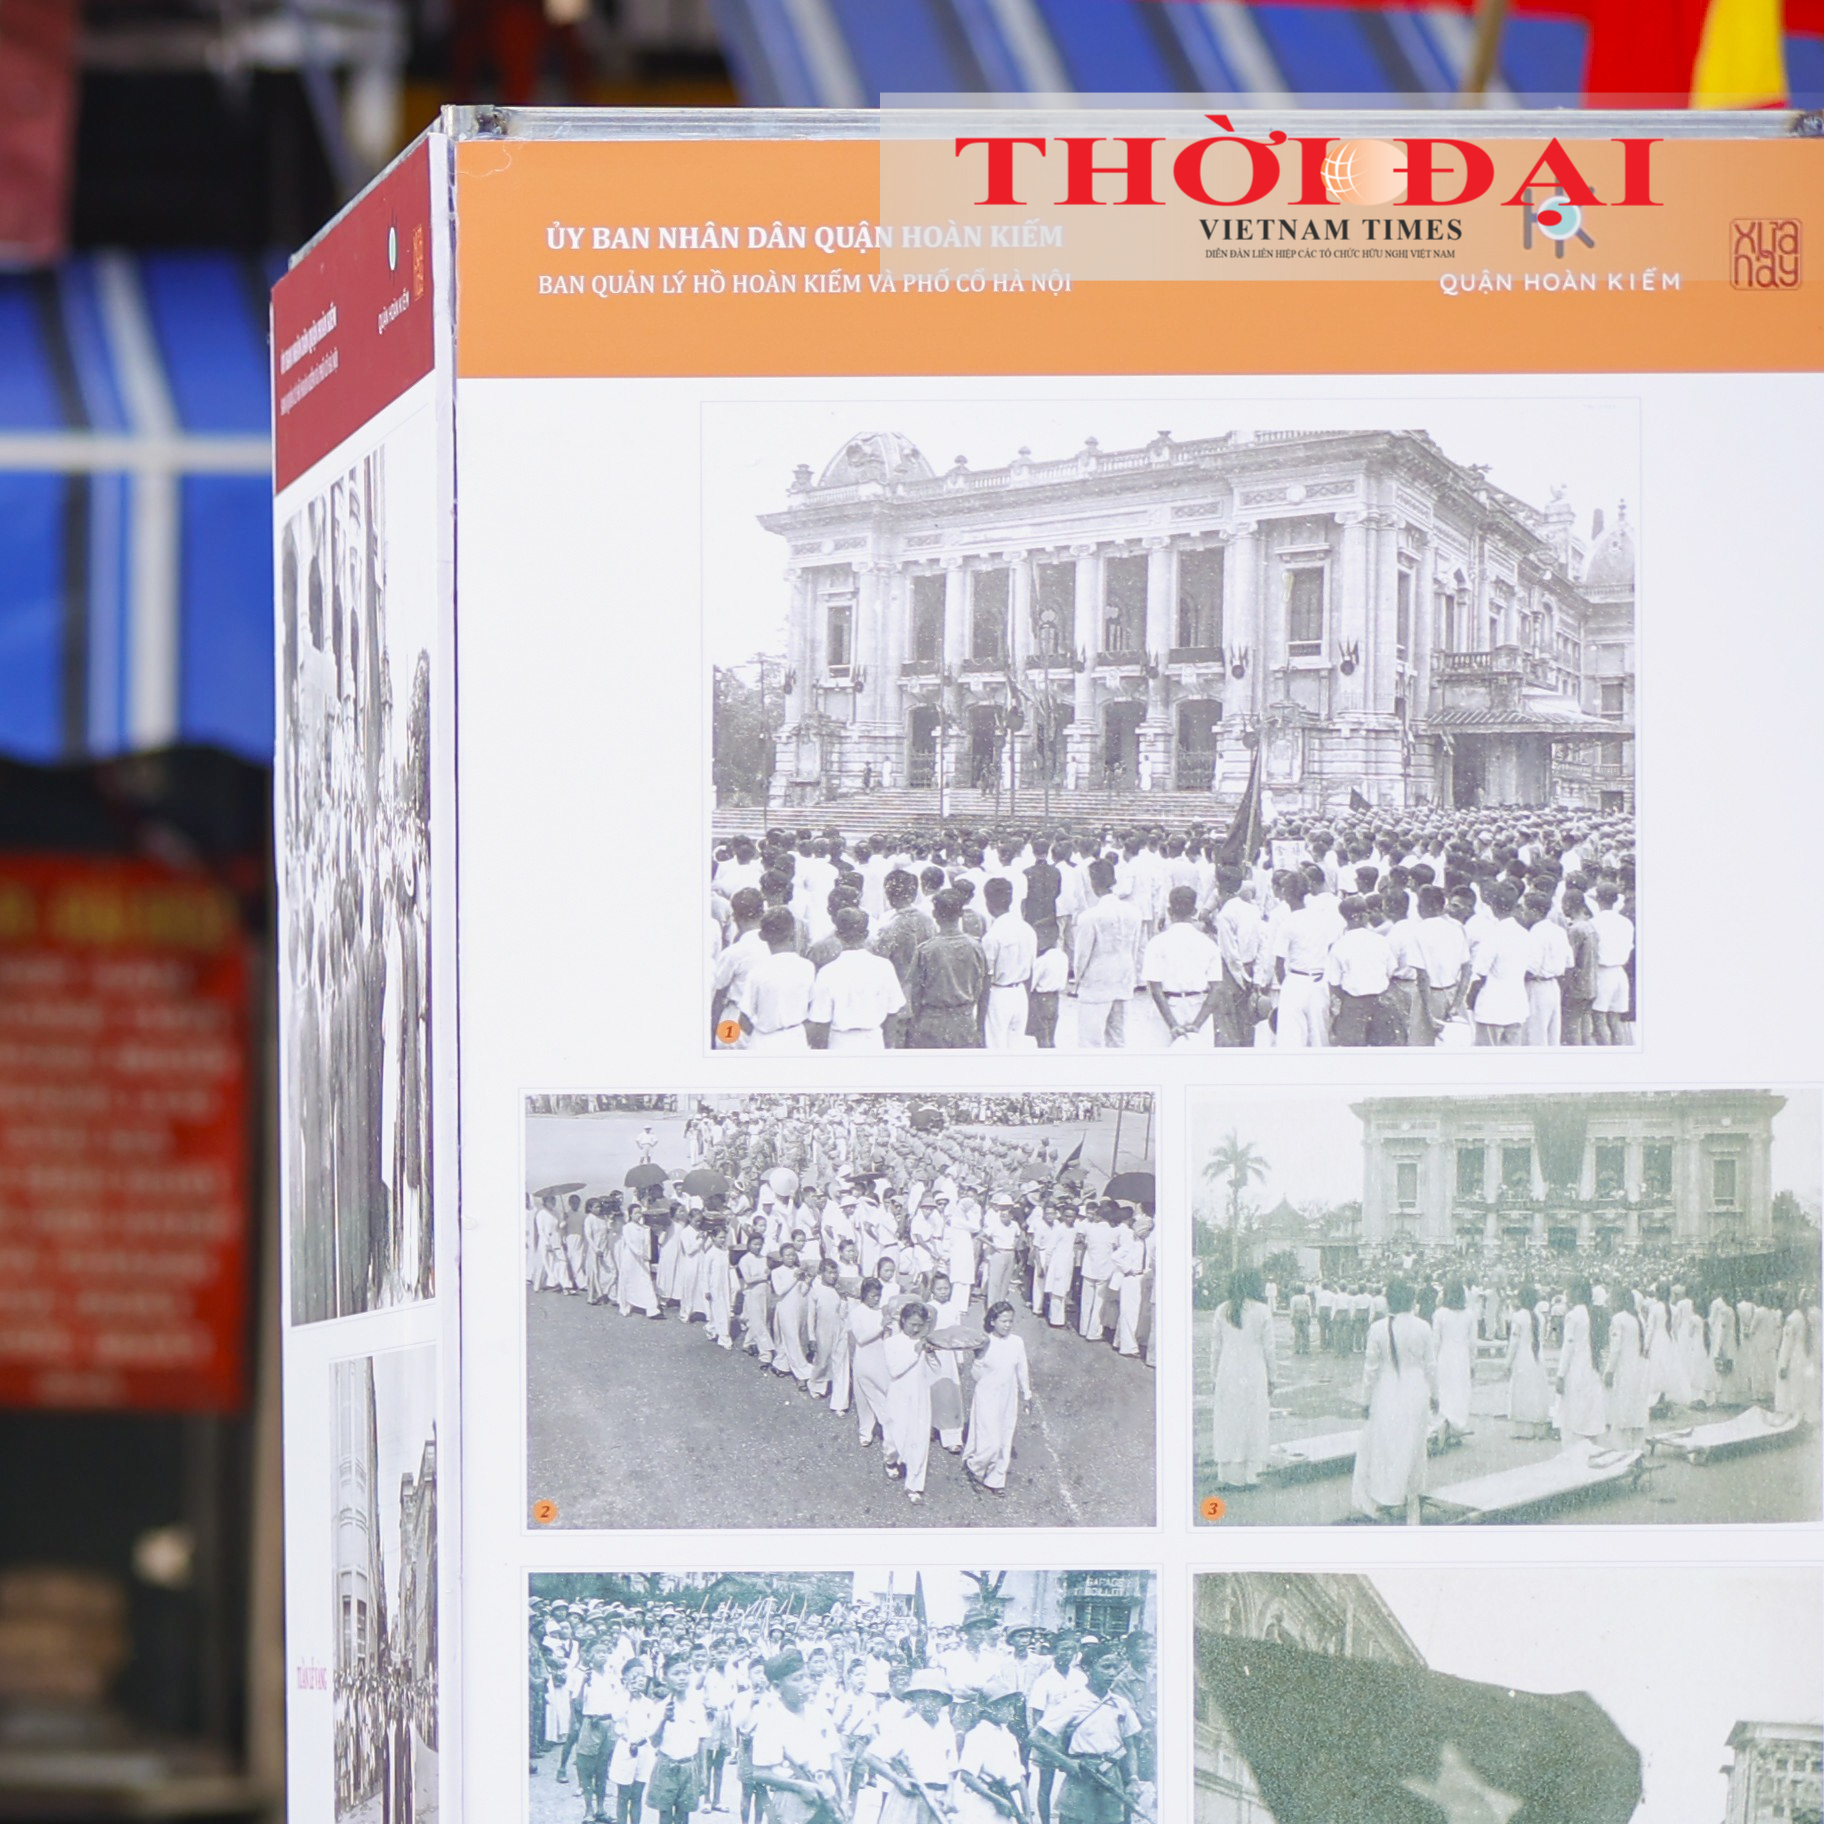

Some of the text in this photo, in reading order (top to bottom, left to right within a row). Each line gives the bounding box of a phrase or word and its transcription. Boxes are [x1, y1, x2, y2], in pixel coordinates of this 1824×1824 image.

[547, 218, 1063, 253] ỦY BAN NHÂN DÂN QUẬN HOÀN KIẾM
[539, 267, 1072, 298] BAN QUẢN LÝ HỒ HOÀN KIẾM VÀ PHỐ CỔ HÀ NỘI
[1440, 268, 1680, 295] QUẬN HOÀN KIẾM
